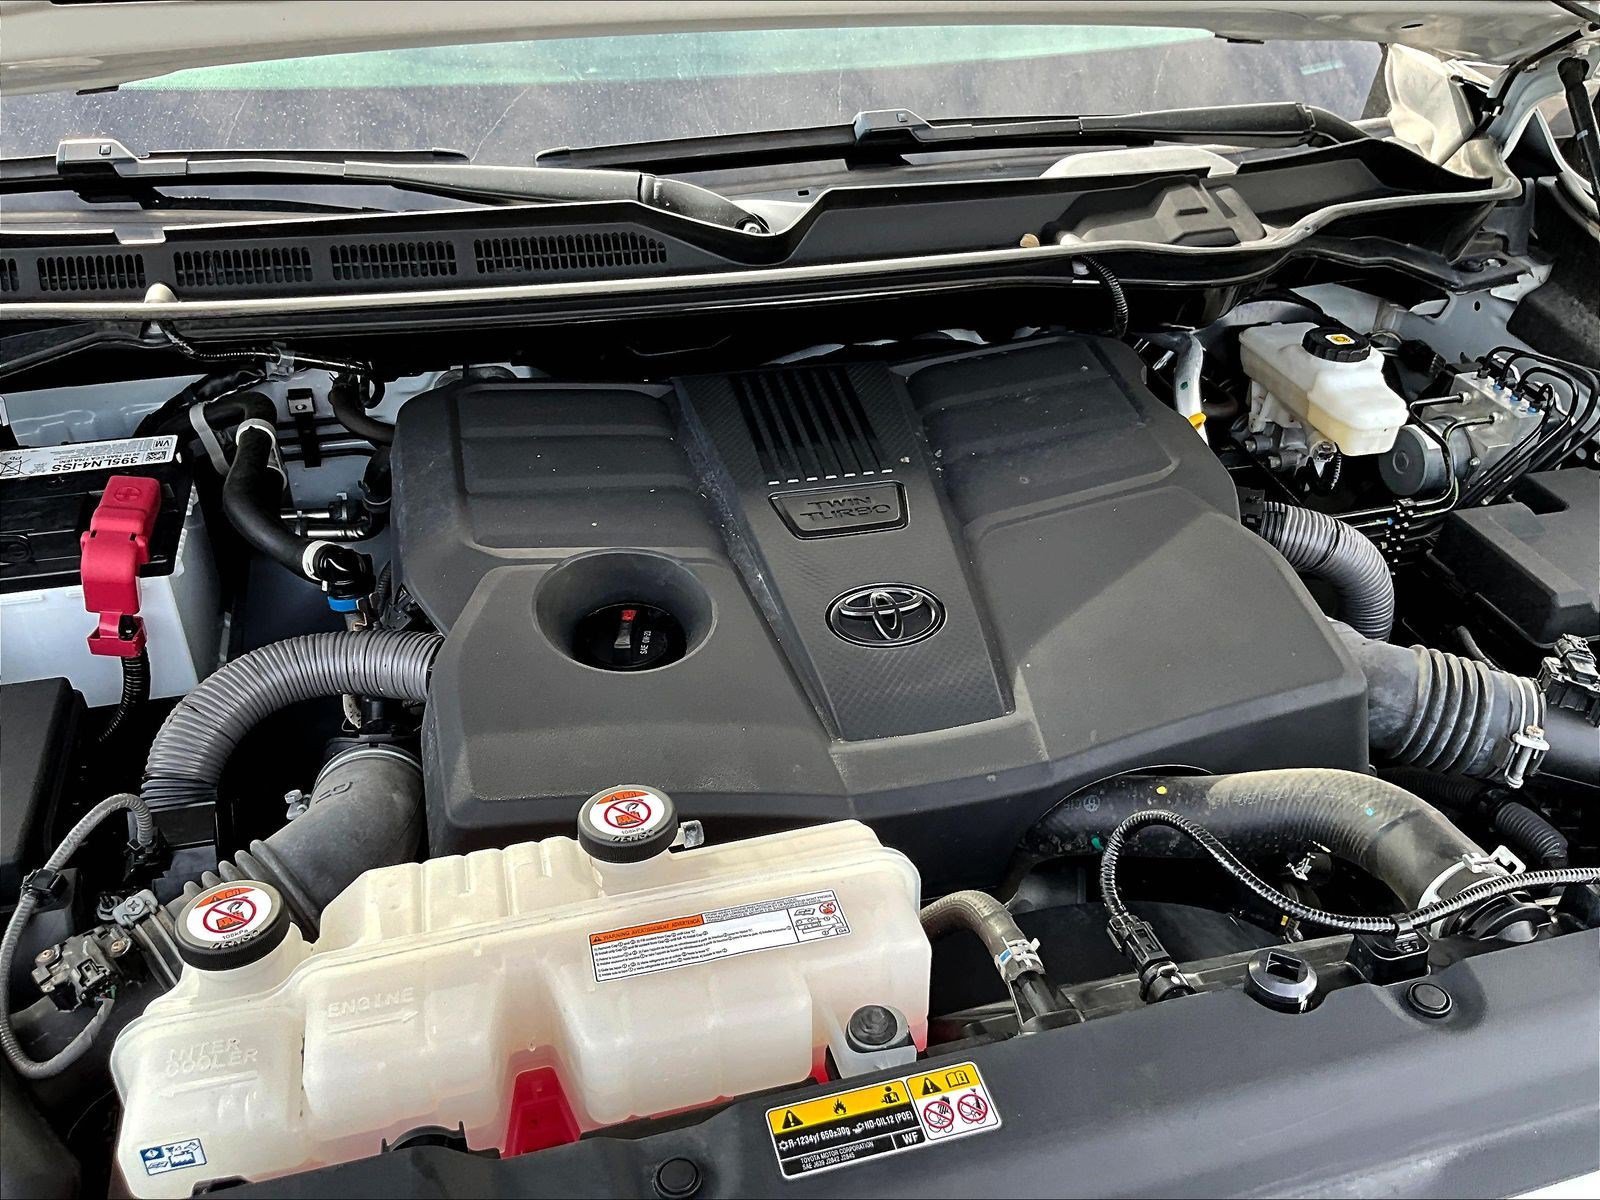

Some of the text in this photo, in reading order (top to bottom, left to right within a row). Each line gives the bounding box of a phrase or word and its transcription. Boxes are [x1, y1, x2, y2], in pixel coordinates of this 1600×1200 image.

[154, 438, 170, 448] VM
[52, 456, 138, 472] 395LN4-ISS
[807, 496, 872, 510] TWIN
[800, 504, 890, 521] TURBO
[209, 930, 259, 950] DENSO
[602, 931, 630, 941] WARNING
[327, 986, 415, 1018] ENGINE
[166, 1049, 258, 1078] COOLER
[788, 1110, 914, 1149] R-1234yf 650±30g ND-OIL12 (POE)
[902, 1132, 918, 1145] WF
[800, 1142, 874, 1164] TOYOTA MOTOR CORPORATION
